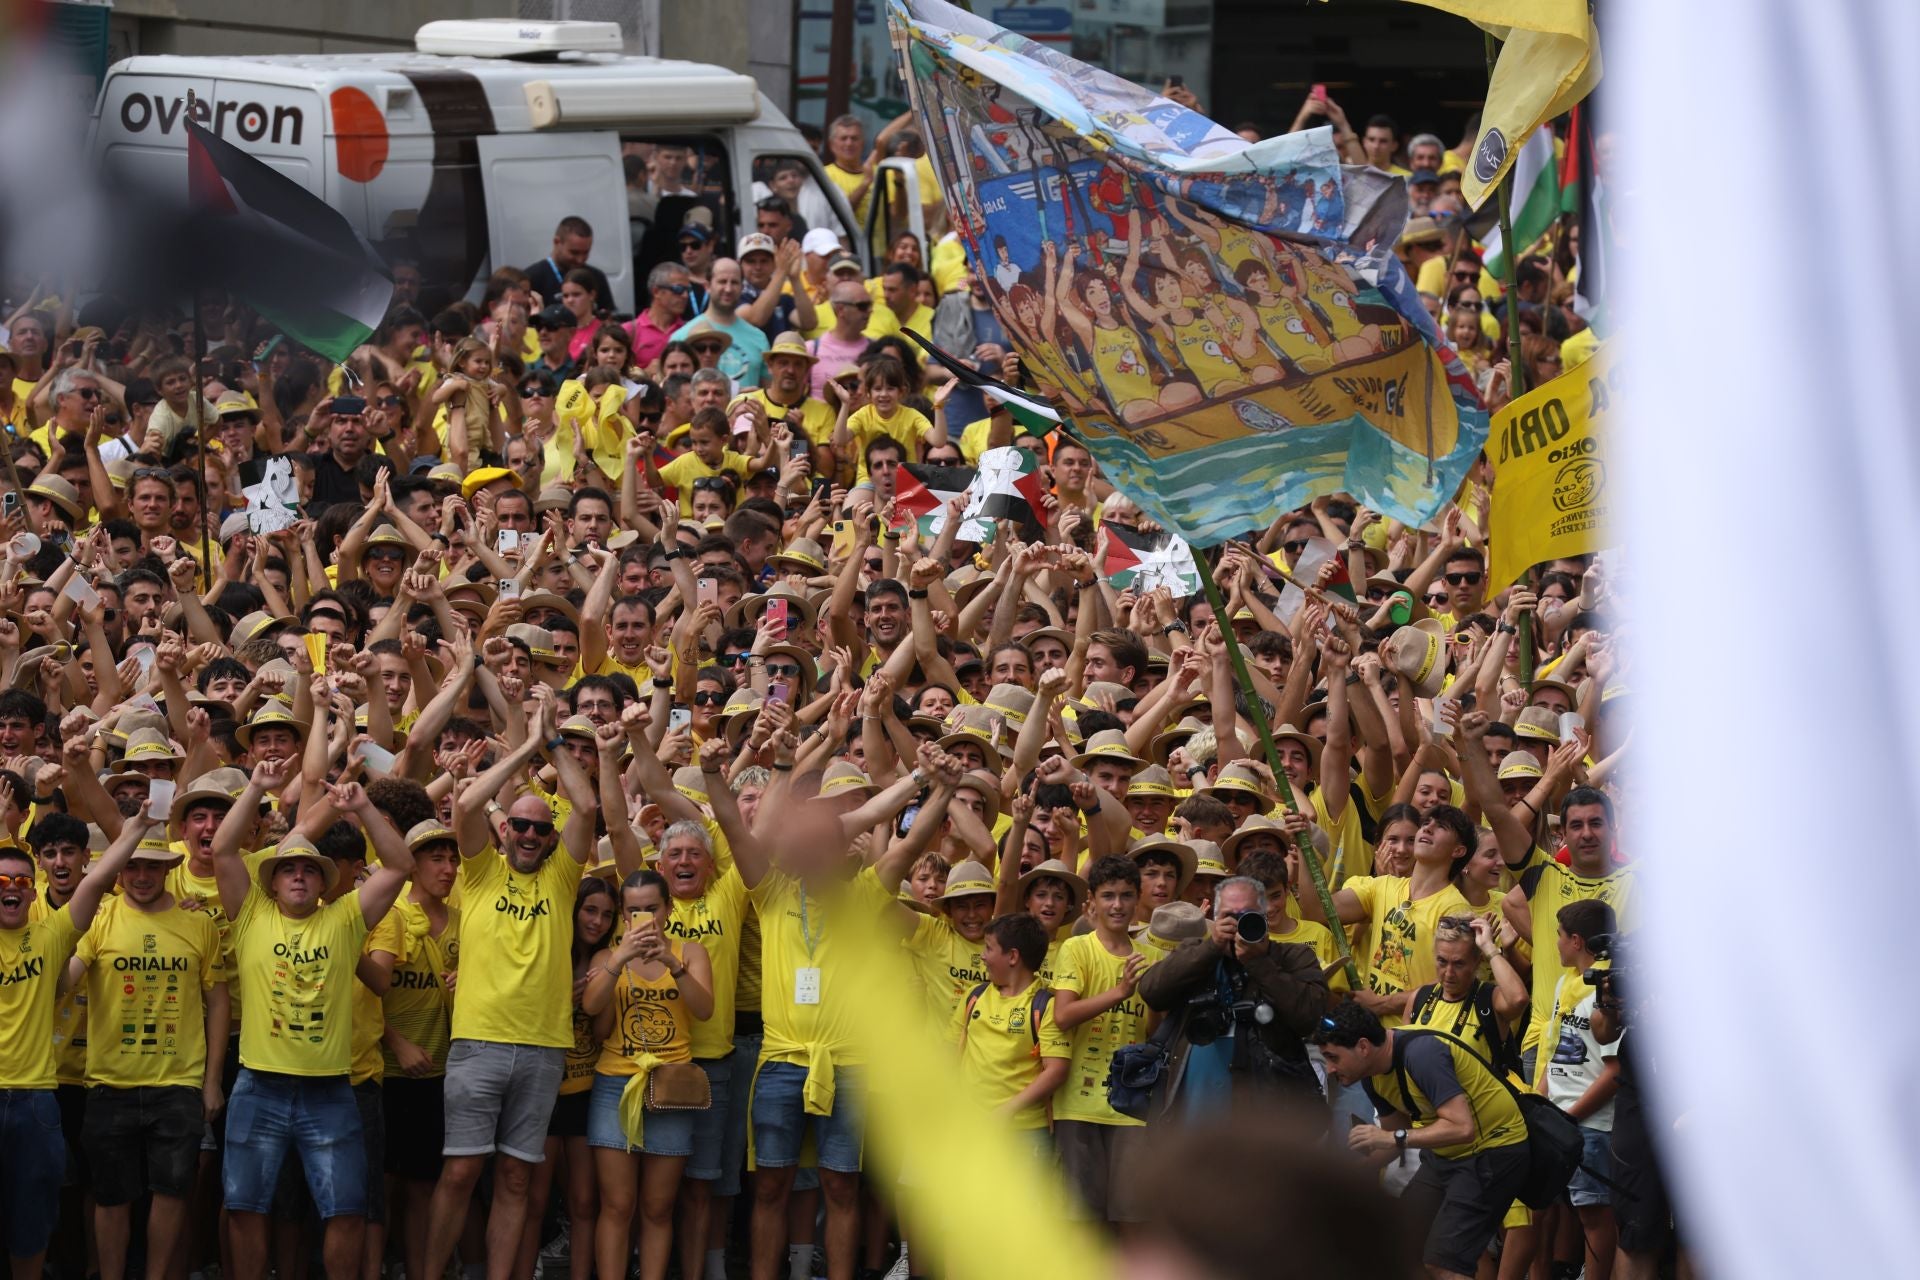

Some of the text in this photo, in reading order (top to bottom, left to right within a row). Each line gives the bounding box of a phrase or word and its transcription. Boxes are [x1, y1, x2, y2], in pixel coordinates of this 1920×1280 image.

[121, 92, 304, 146] overon
[1384, 907, 1416, 942] APA
[113, 956, 188, 972] ORIALKI
[950, 965, 991, 983] ORIAL
